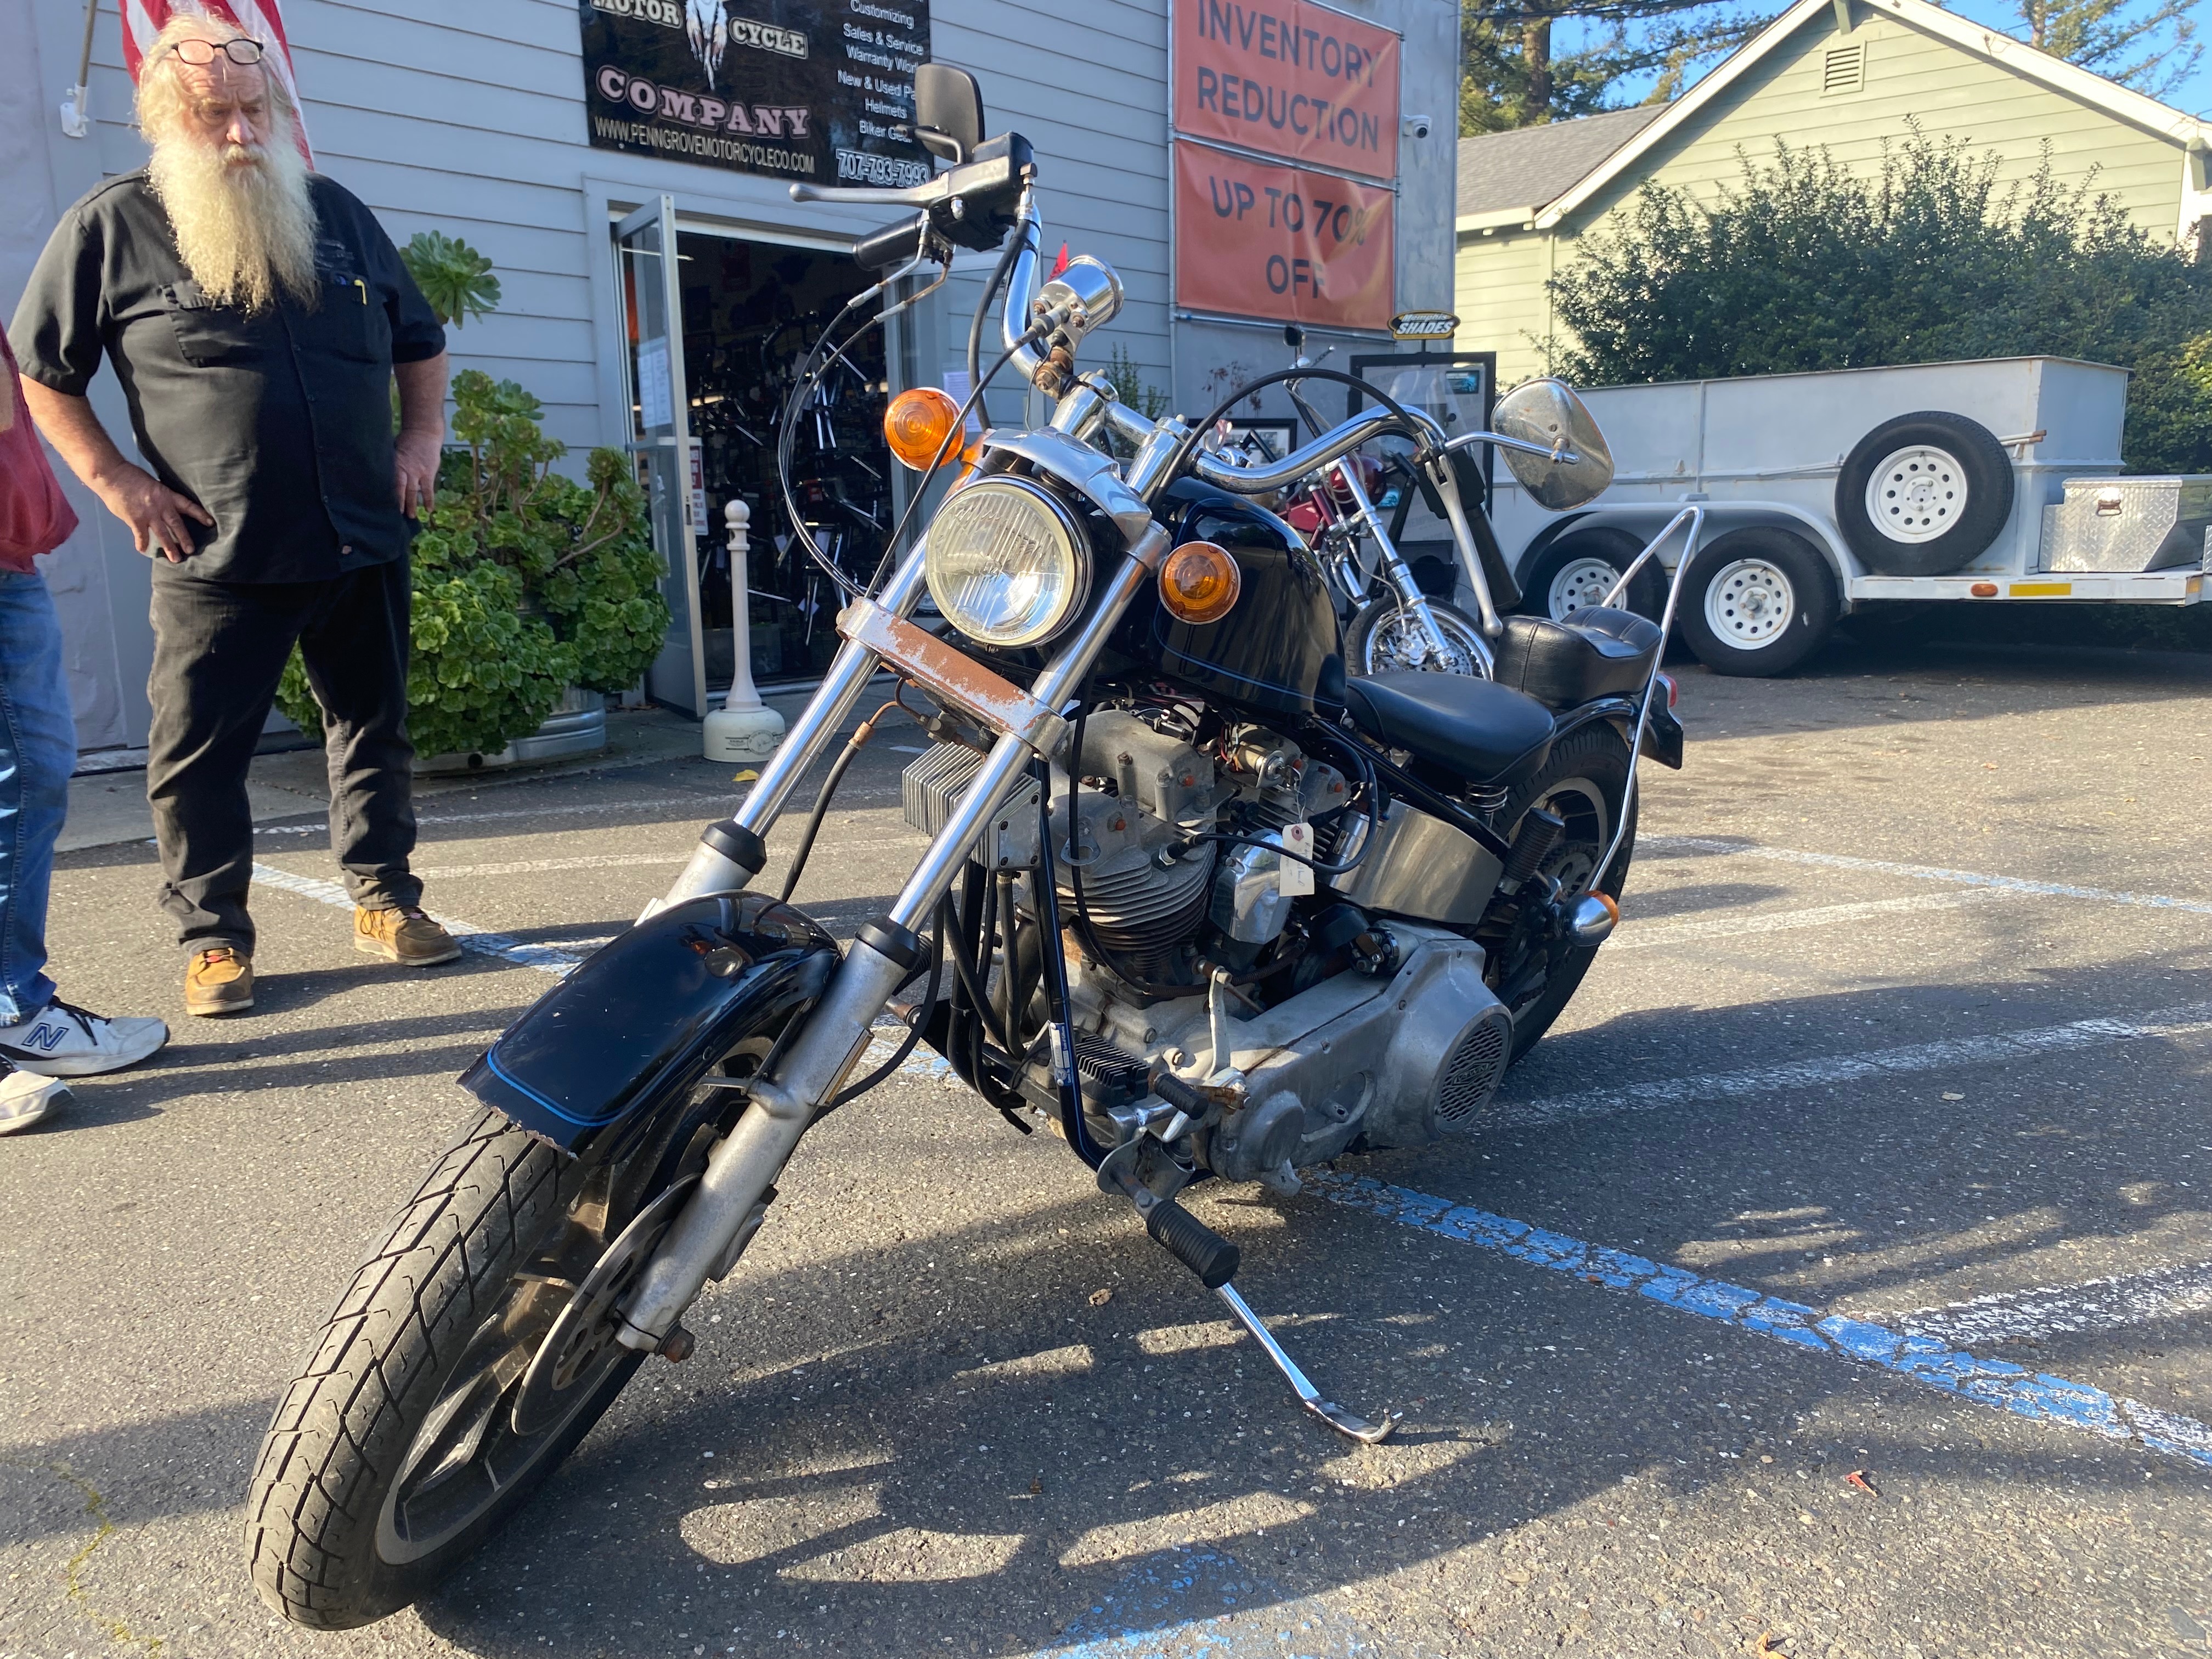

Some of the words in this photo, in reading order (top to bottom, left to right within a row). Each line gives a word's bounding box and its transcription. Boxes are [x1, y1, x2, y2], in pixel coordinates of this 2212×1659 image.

[850, 0, 915, 30] Customizing
[731, 18, 807, 57] CYCLE
[843, 22, 873, 43] Sales
[875, 30, 884, 46] &
[885, 34, 924, 55] Service
[1198, 0, 1381, 88] INVENTORY
[846, 44, 894, 71] Warranty
[837, 69, 862, 87] New
[864, 76, 873, 90] &
[874, 78, 902, 97] Used
[598, 67, 809, 137] COMPANY
[865, 98, 907, 119] Helmets
[1197, 66, 1379, 153] REDUCTION
[594, 115, 815, 174] WWW.PENNGROVEMOTORCYCLECO.COM
[859, 120, 886, 137] Biker
[837, 150, 929, 188] 707-793-7993
[1209, 176, 1255, 221] UP
[1264, 187, 1305, 233] TO
[1313, 200, 1367, 246] 70%
[1266, 255, 1325, 299] OFF
[1396, 321, 1454, 334] SHADES
[1402, 313, 1448, 323] Memphis
[21, 1023, 69, 1051] N
